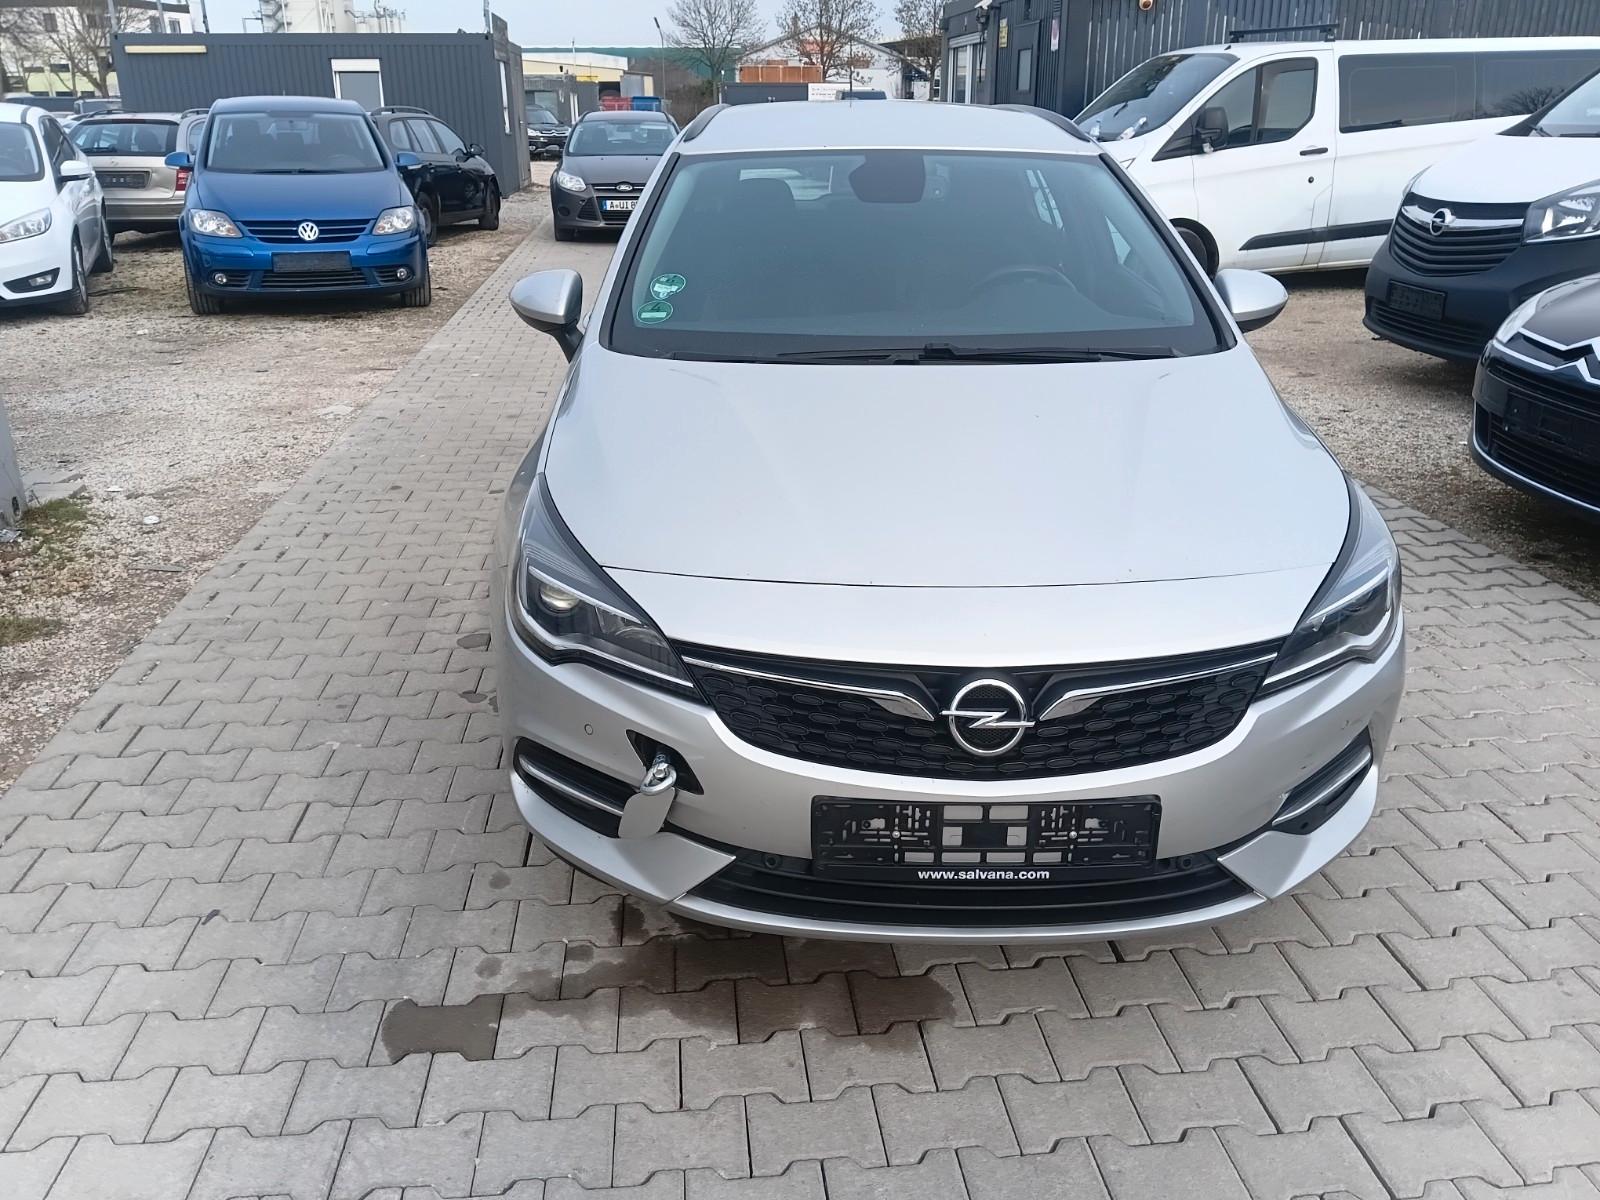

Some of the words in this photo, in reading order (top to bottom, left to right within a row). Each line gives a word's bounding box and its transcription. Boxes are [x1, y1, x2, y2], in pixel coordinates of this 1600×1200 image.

[610, 201, 615, 209] A
[619, 201, 628, 209] UI
[298, 221, 319, 241] VW
[917, 869, 1050, 880] www.salvana.com
